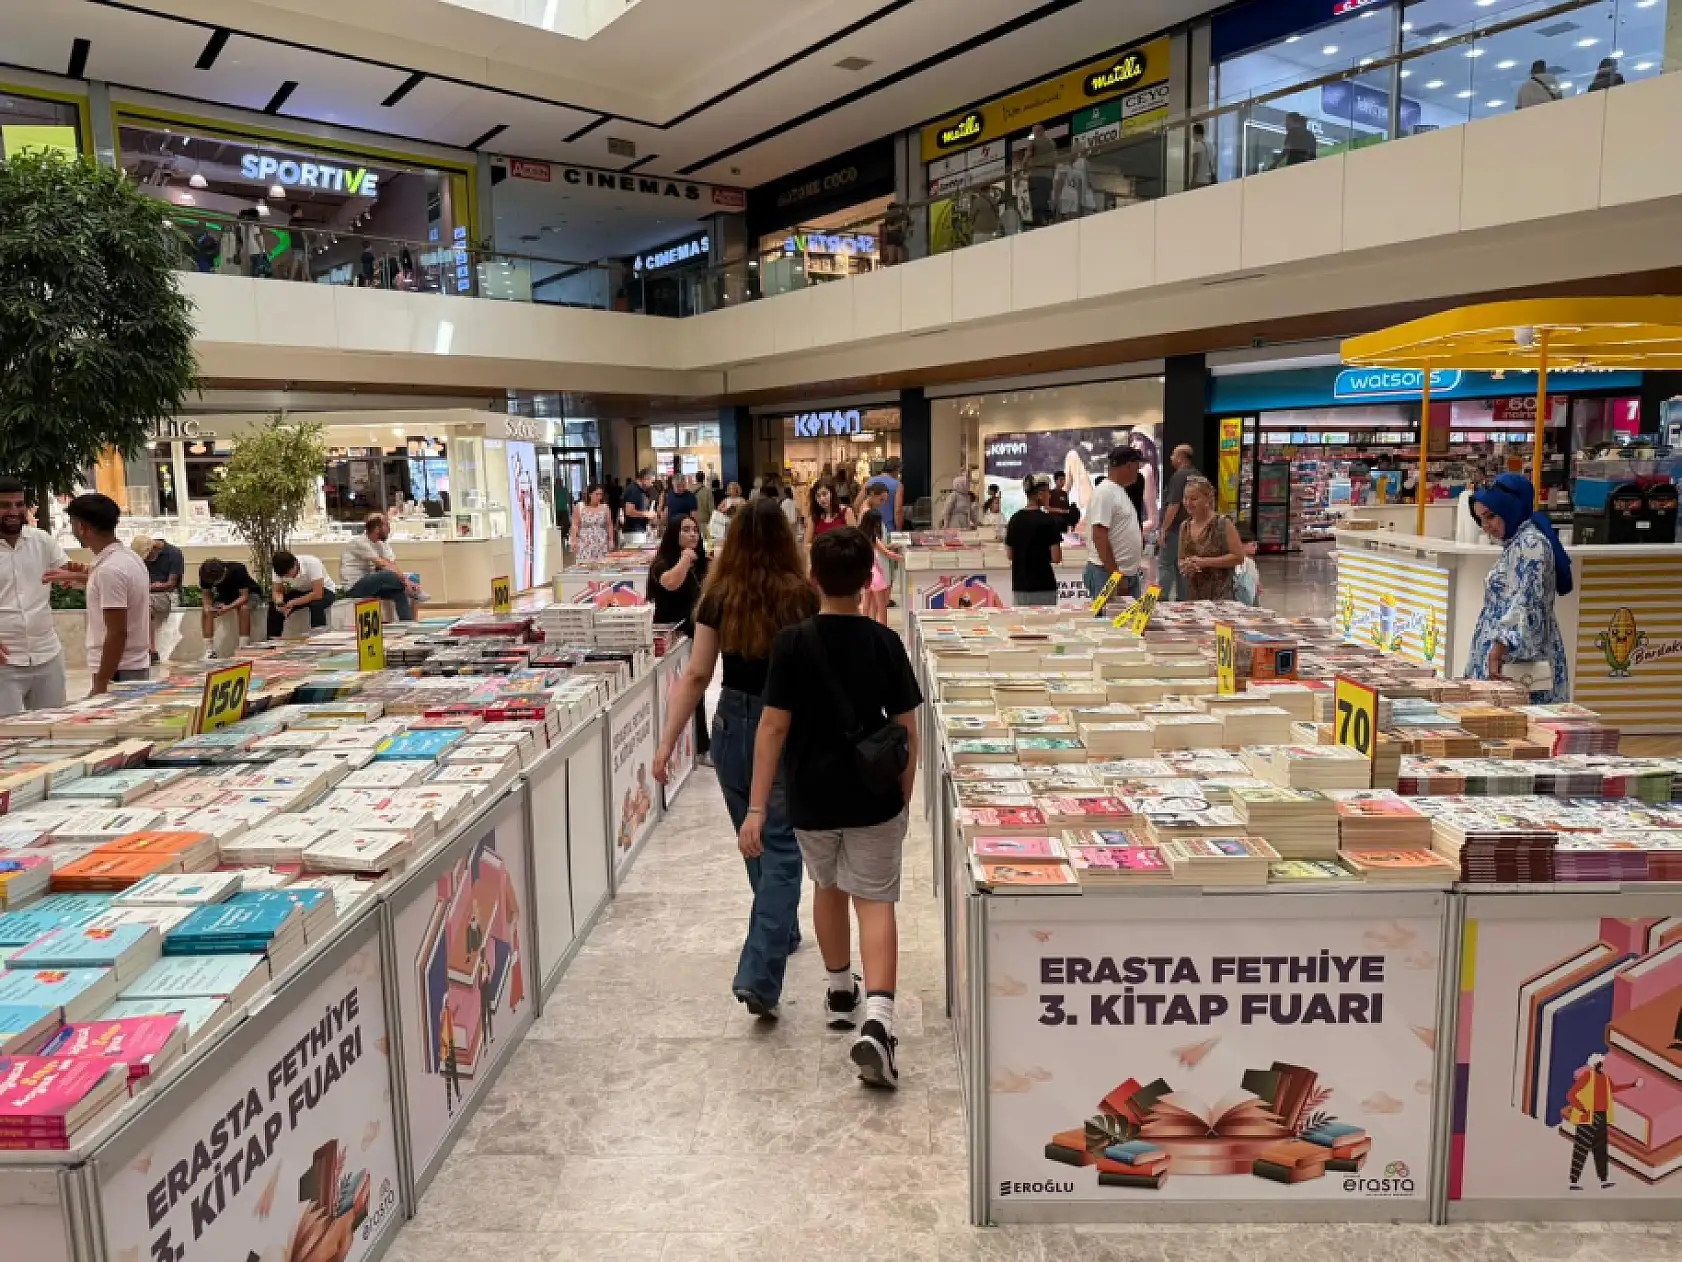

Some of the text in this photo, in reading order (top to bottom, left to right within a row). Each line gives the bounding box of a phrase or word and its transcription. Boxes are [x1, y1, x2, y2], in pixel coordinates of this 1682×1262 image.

[240, 153, 380, 196] SPORTIVE
[563, 168, 700, 200] CINEMAS
[646, 236, 710, 270] CINEMAS
[794, 409, 861, 437] KOTON
[359, 610, 380, 640] 150
[207, 676, 245, 717] 150
[1337, 698, 1371, 755] 70
[1040, 949, 1385, 985] ERASTA FETHİYE
[1039, 986, 1383, 1026] 3. KİTAP FUARI
[146, 985, 360, 1231] ERASTA FETHİYE
[190, 1110, 283, 1242] KİTAP
[287, 1024, 363, 1132] FUARI
[1013, 1178, 1074, 1193] EROĞLU
[1342, 1178, 1415, 1192] erasta
